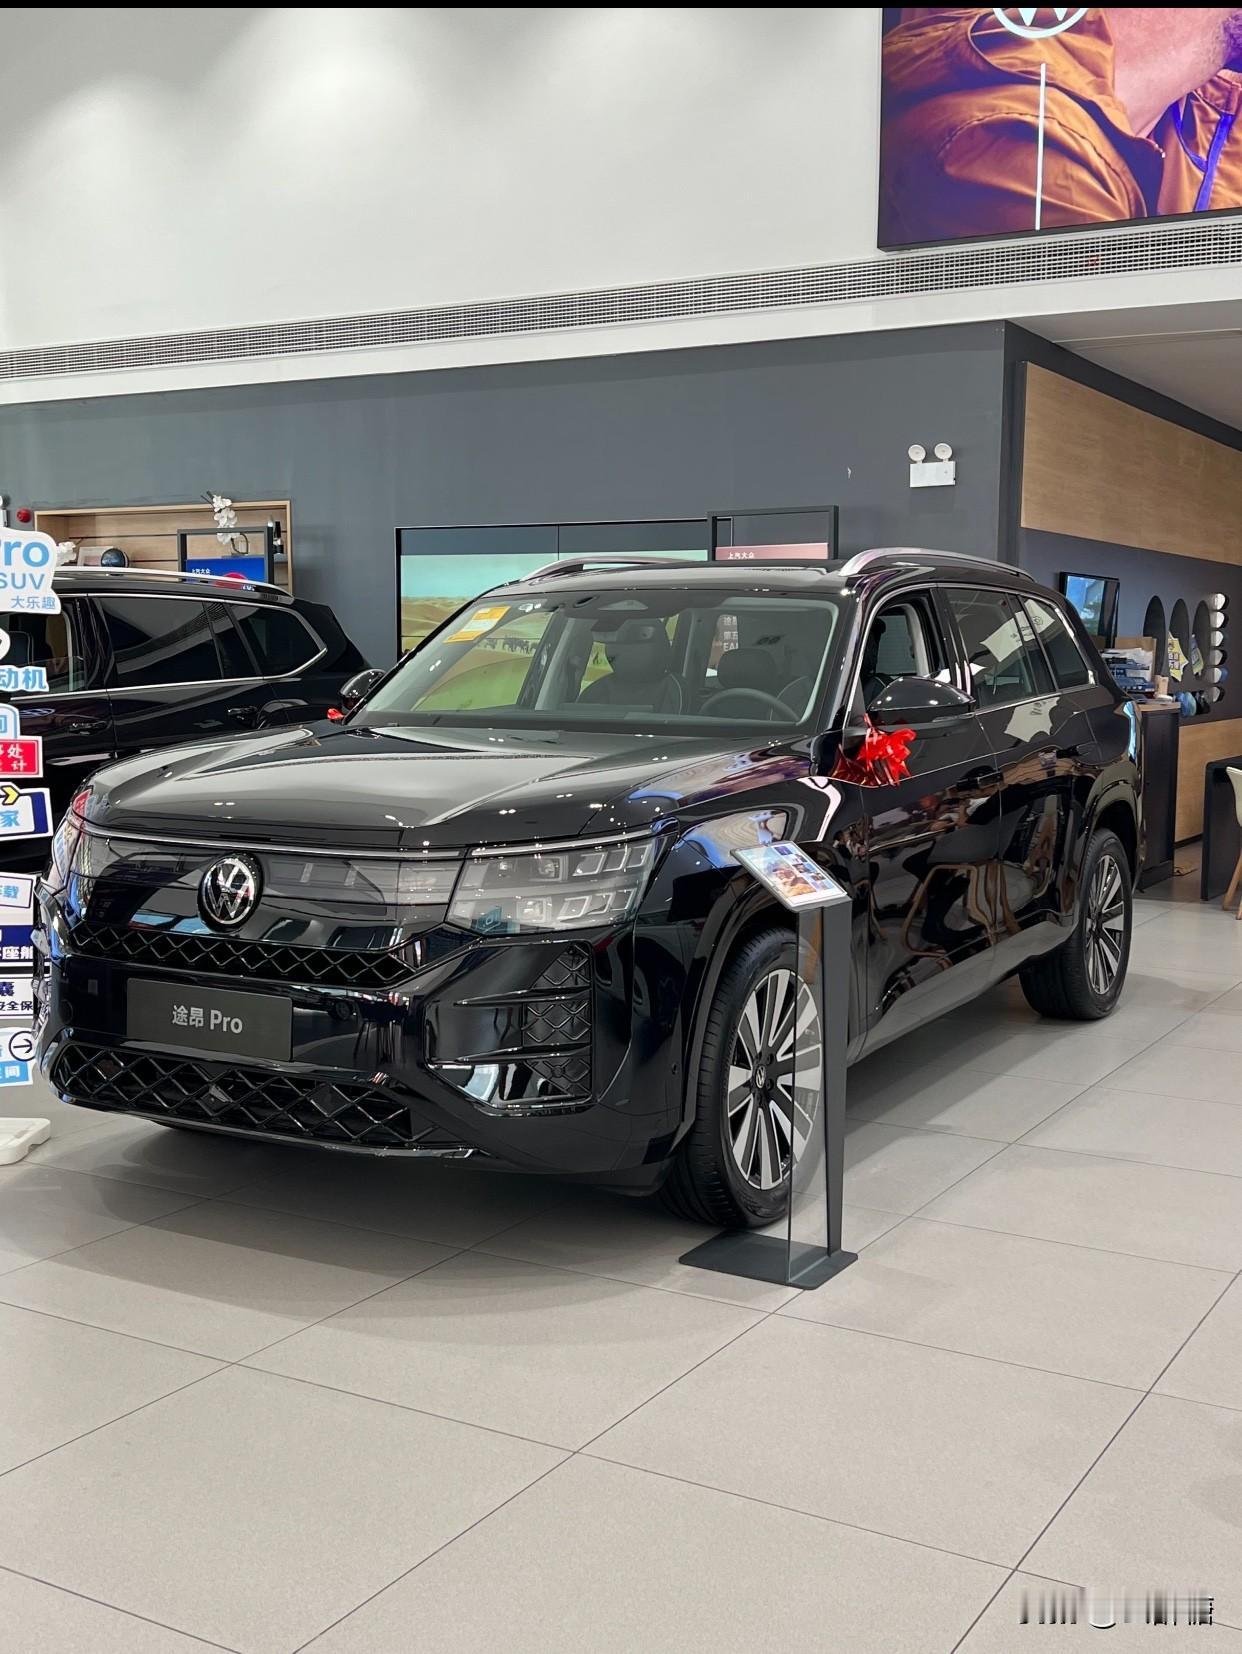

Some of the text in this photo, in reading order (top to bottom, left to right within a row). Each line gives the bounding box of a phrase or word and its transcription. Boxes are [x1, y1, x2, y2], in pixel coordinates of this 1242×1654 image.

[0, 541, 49, 567] ro
[172, 1005, 243, 1034] 途昂 Pro
